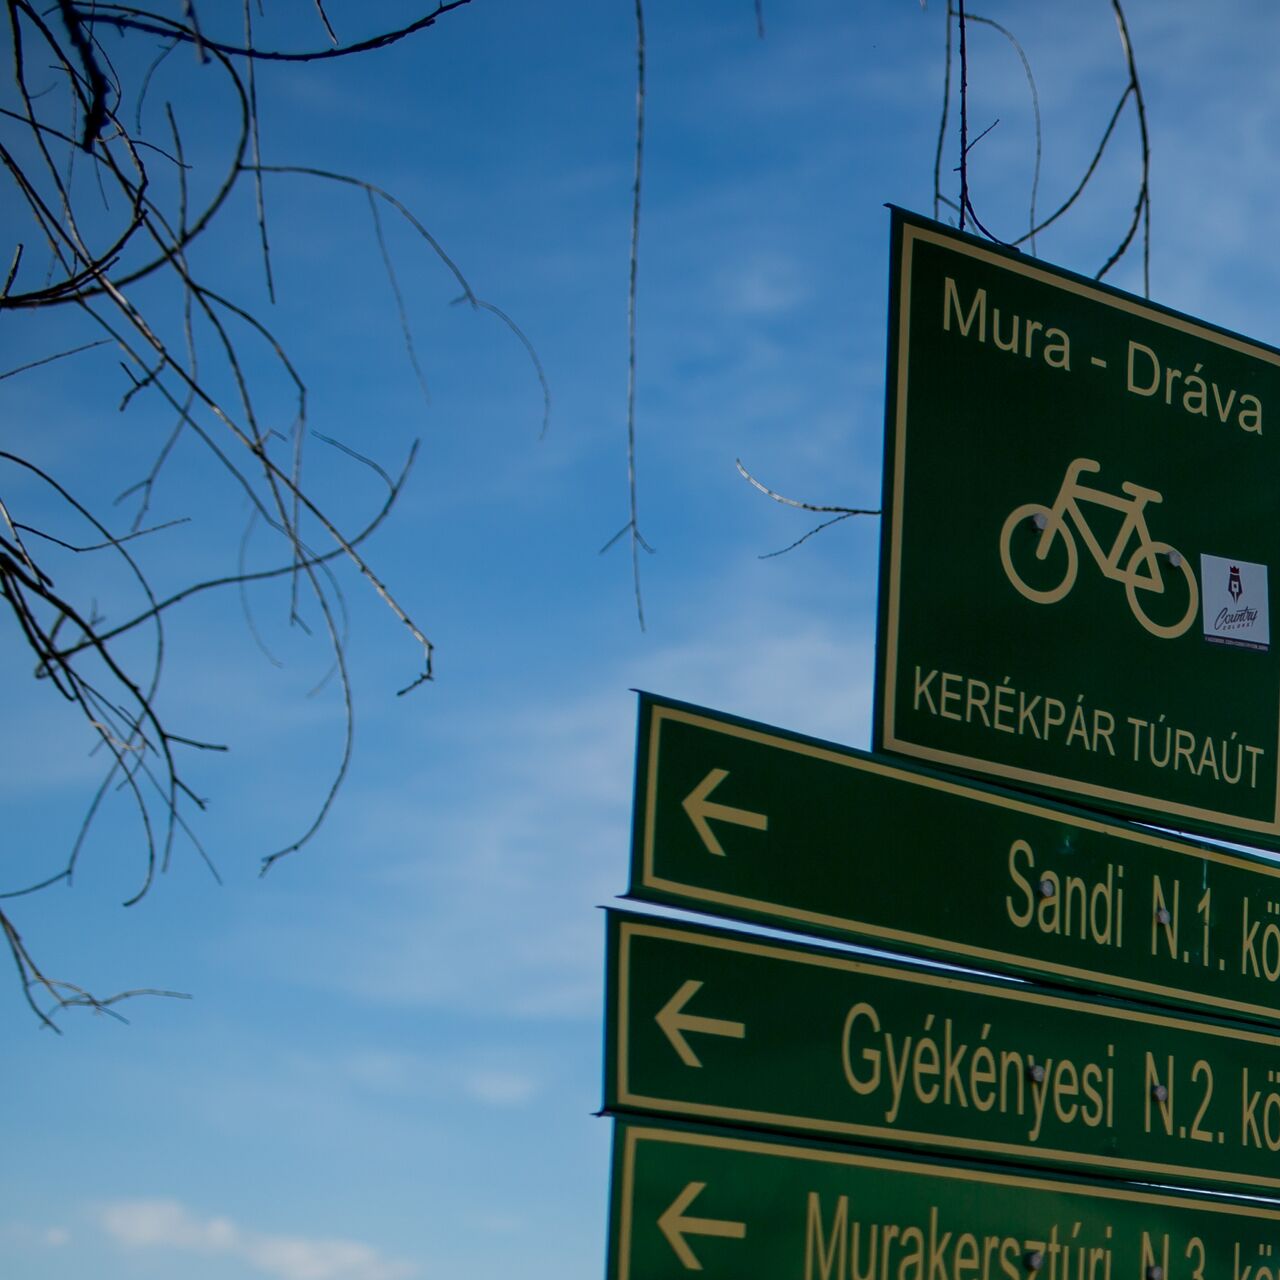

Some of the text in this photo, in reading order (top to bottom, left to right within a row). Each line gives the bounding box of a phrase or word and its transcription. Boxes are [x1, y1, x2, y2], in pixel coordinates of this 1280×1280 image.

[944, 277, 1263, 434] Mura - Dráva
[914, 665, 1264, 788] KERÉKPÁR TÚRAÚT
[1007, 840, 1123, 947] Sandi
[842, 1002, 1115, 1141] Gyékényesi
[1146, 1052, 1224, 1143] N.2.
